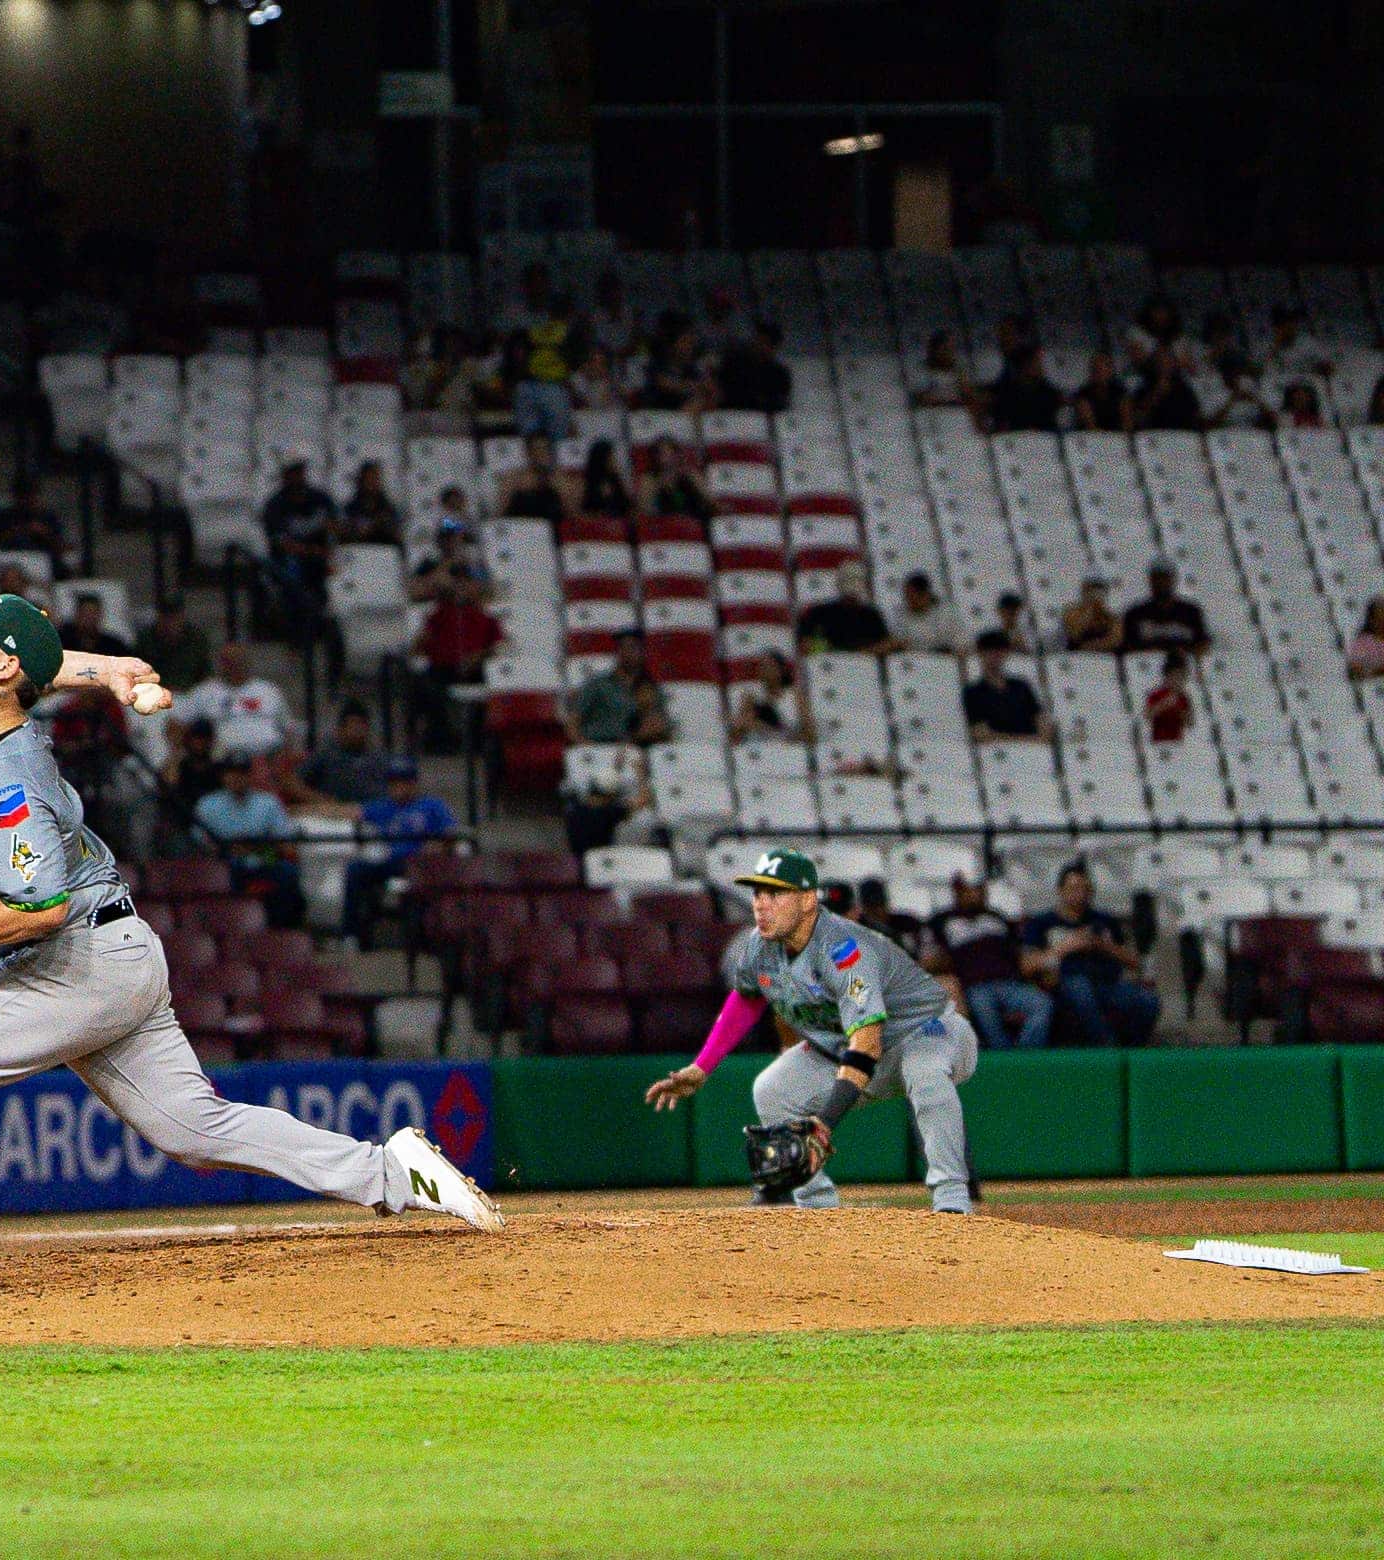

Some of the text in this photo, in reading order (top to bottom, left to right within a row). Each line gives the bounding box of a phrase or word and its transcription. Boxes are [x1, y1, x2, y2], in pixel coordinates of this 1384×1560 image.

[755, 854, 783, 875] M
[267, 1080, 426, 1147] CO
[409, 1167, 441, 1204] N
